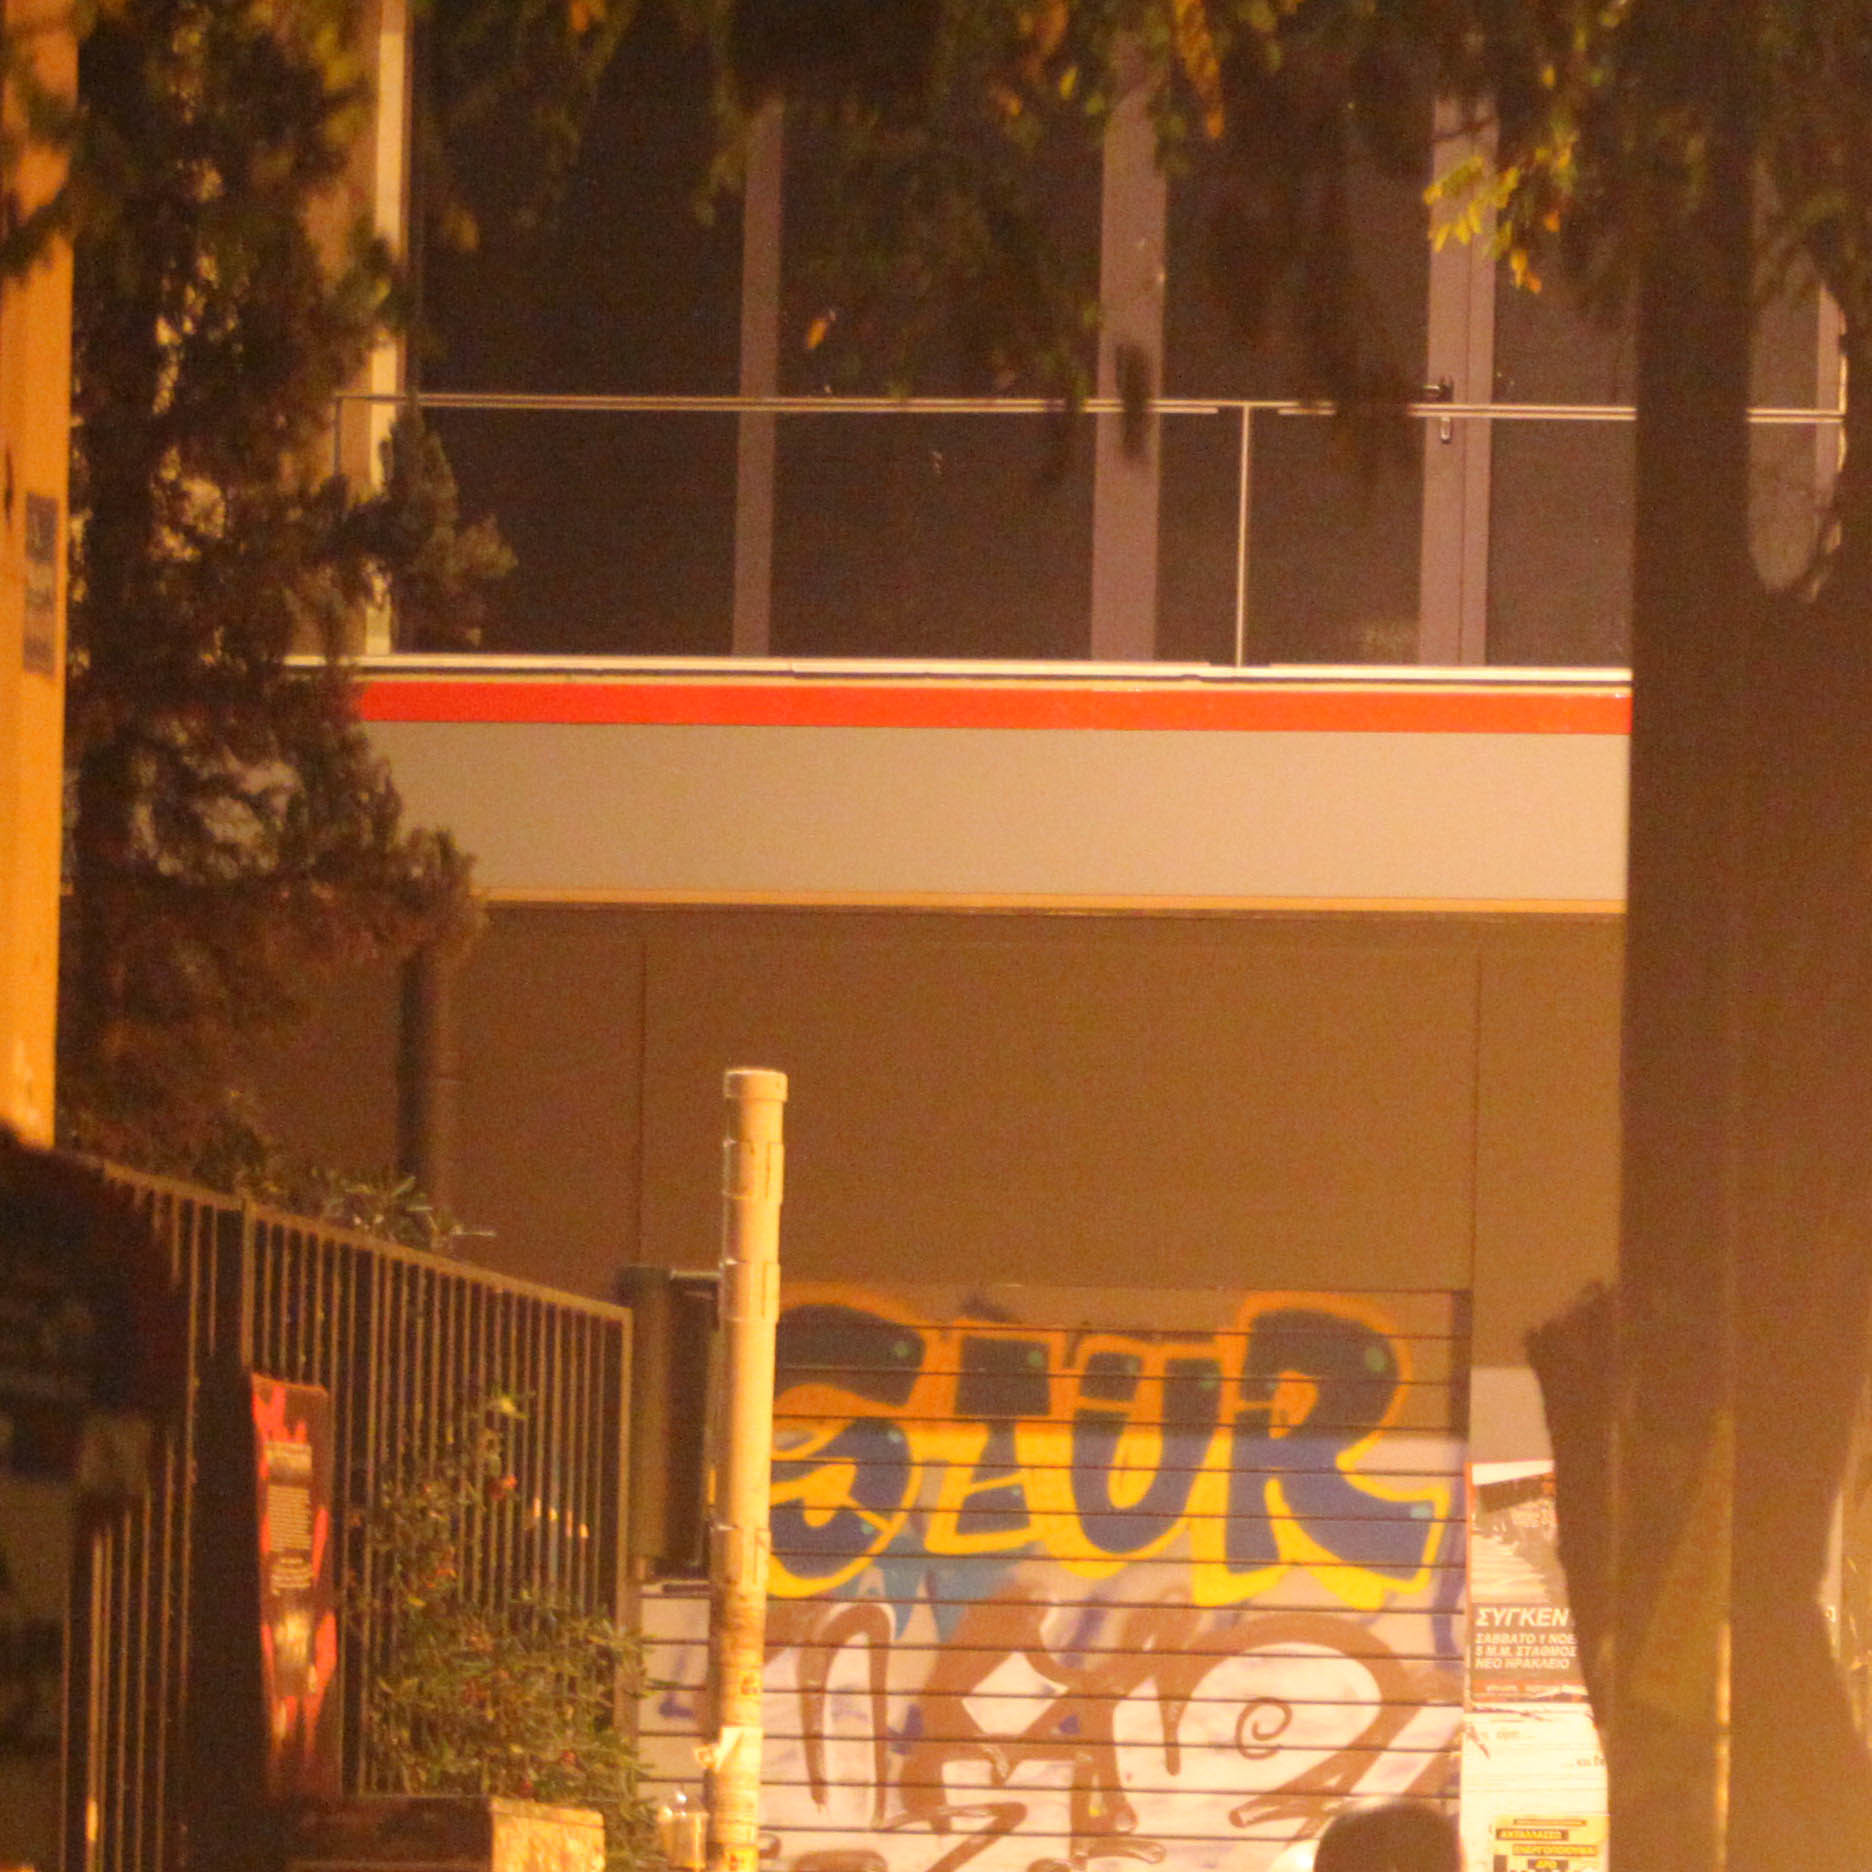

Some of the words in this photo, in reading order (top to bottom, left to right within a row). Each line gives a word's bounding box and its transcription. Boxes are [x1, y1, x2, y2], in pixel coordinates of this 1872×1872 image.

[1475, 1606, 1570, 1628] ΣΥΓΚΕΝ
[1475, 1632, 1536, 1645] ΣΑΒΒΑΤΟ
[1516, 1645, 1577, 1658] ΣΤΑΘΜΟΣ
[1475, 1657, 1502, 1670] ΝΕΟ
[1504, 1657, 1570, 1670] ΗΡΑΚΛΕΙΟ
